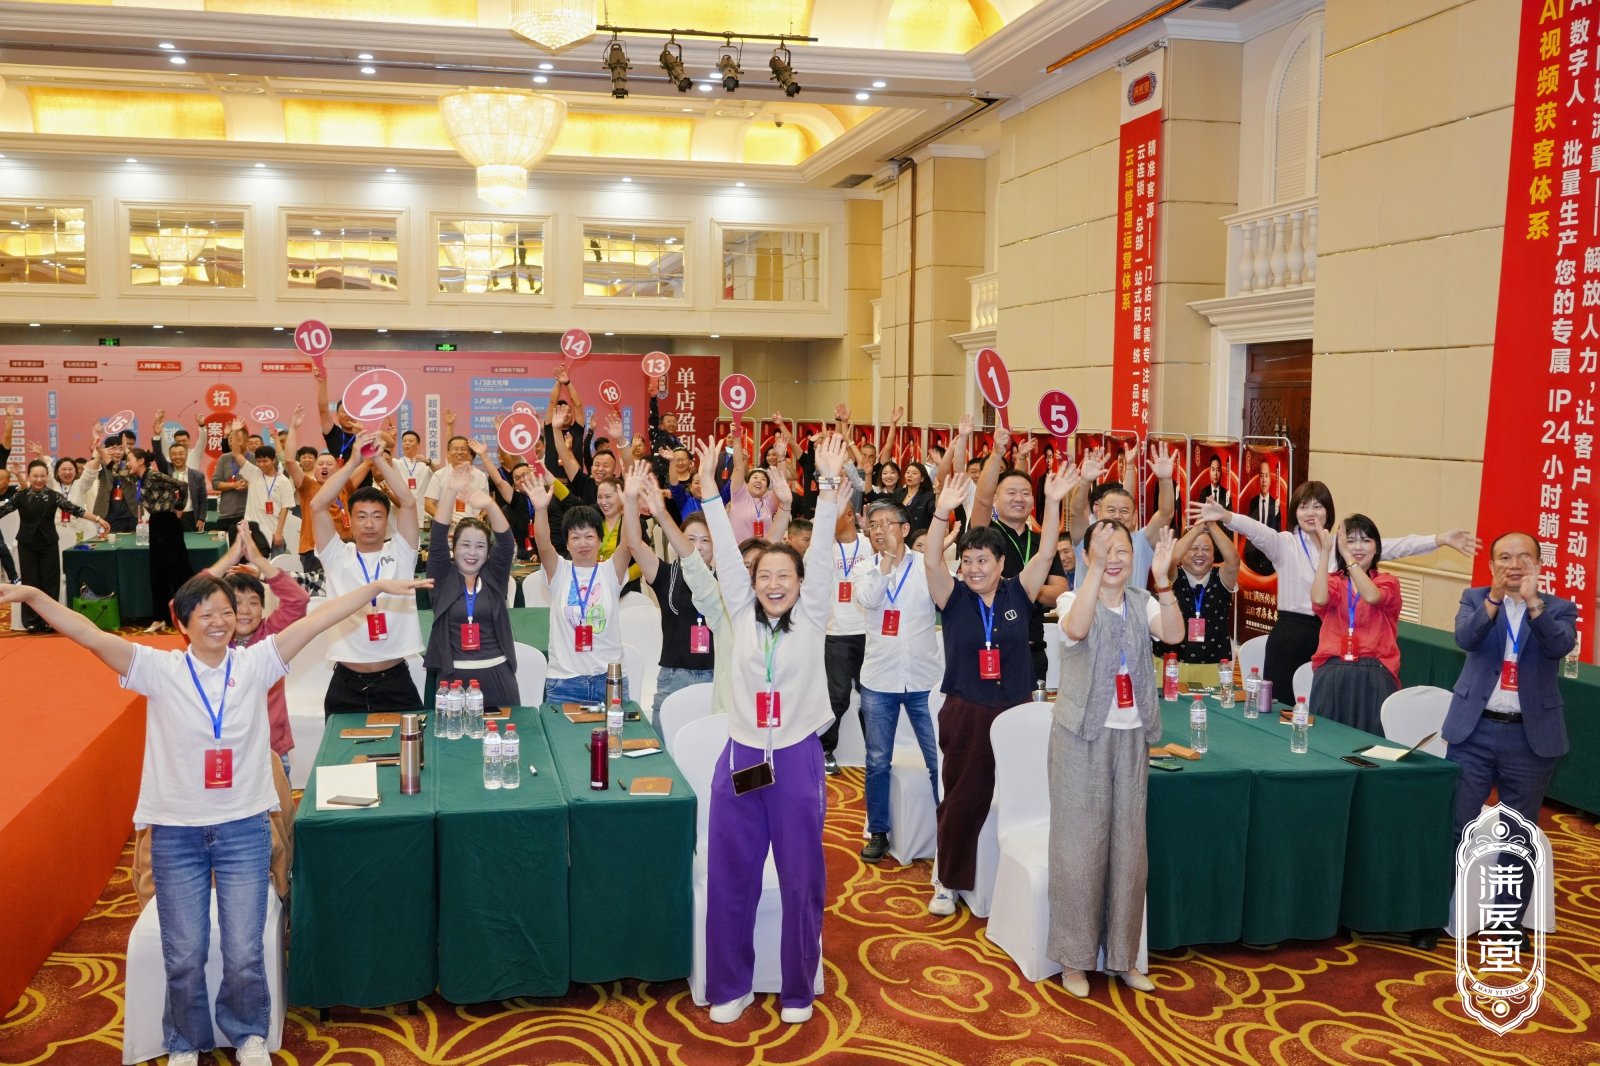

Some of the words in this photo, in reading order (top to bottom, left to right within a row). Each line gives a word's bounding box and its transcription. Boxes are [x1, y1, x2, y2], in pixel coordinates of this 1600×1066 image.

[299, 328, 327, 351] 10
[564, 335, 586, 356] 14
[647, 359, 666, 373] 13
[603, 386, 619, 402] 18
[987, 366, 1004, 403] 1
[213, 390, 231, 407] 拓
[360, 383, 388, 417] 2
[729, 385, 747, 409] 9
[108, 415, 128, 432] 15
[255, 409, 275, 421] 20
[675, 367, 697, 468] 单店盈利
[1050, 404, 1069, 434] 5
[427, 399, 438, 460] 超级成交体系
[509, 423, 533, 450] 6
